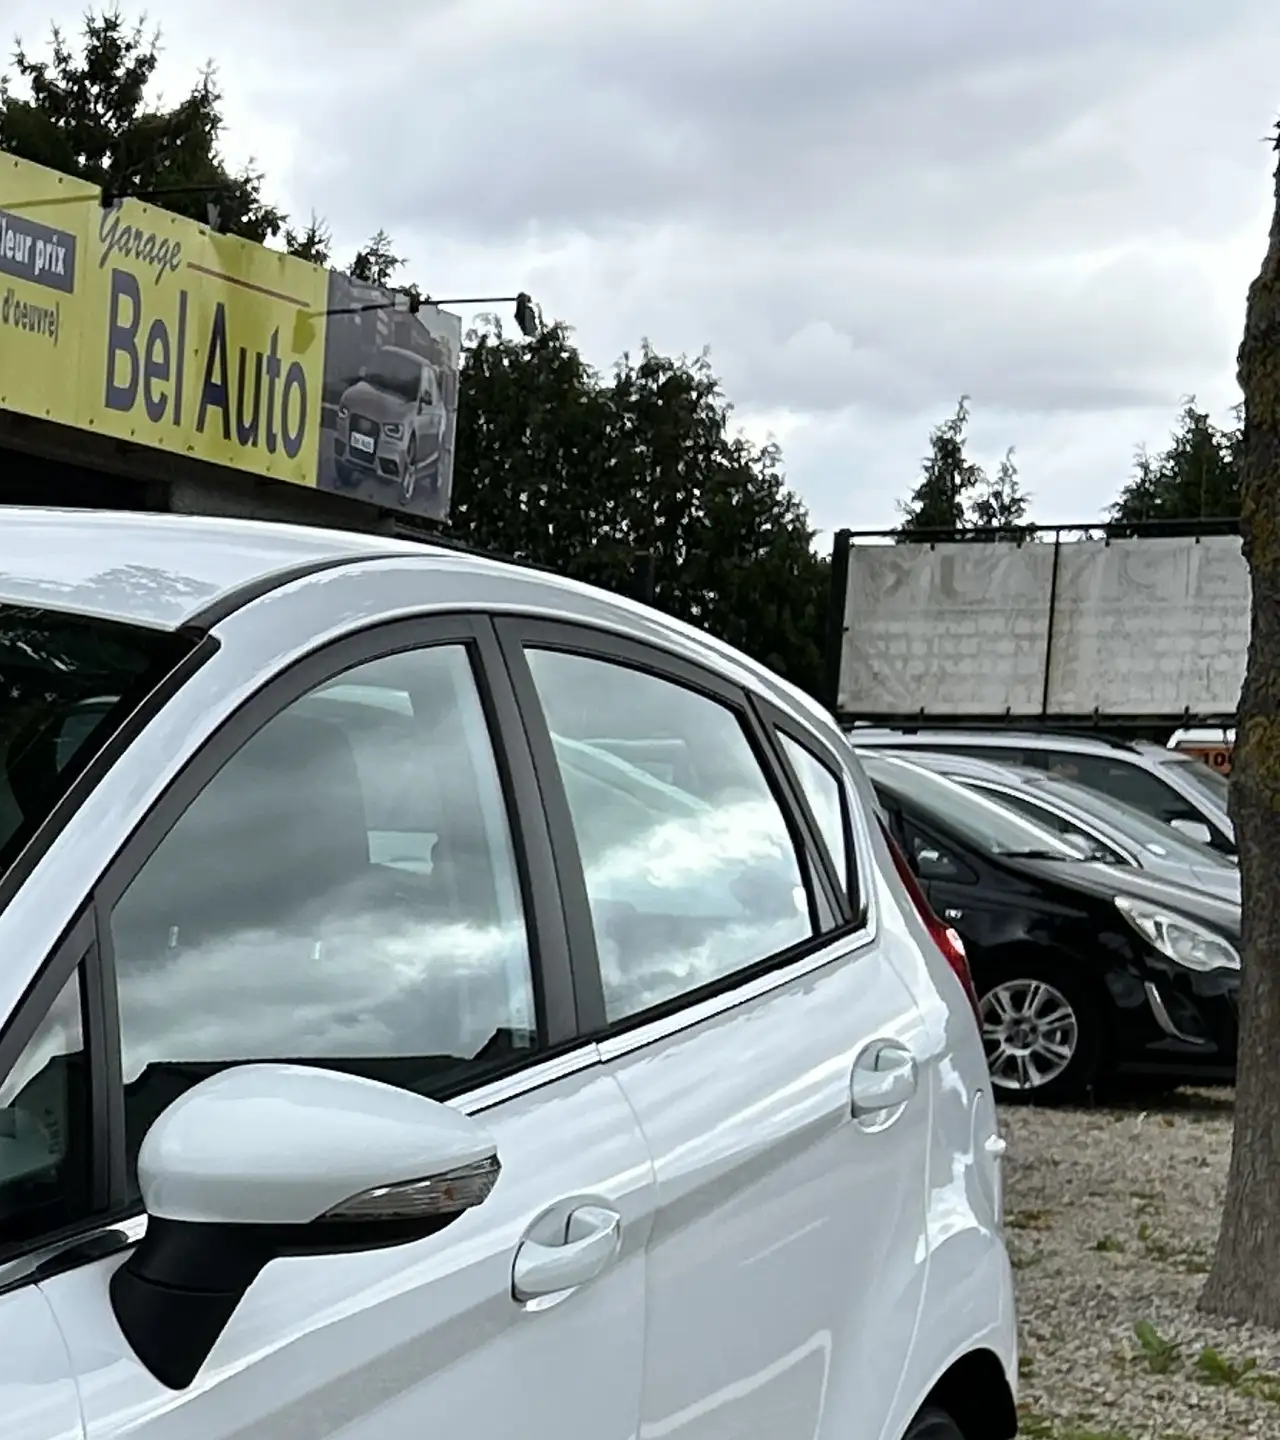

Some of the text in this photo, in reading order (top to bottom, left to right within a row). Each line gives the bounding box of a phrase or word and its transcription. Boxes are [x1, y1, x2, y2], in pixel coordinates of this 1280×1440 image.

[35, 235, 66, 275] prix
[99, 199, 183, 285] Garage
[2, 287, 59, 348] d'oeuvre)
[104, 267, 308, 460] Bel Auto
[1203, 751, 1232, 767] 10
